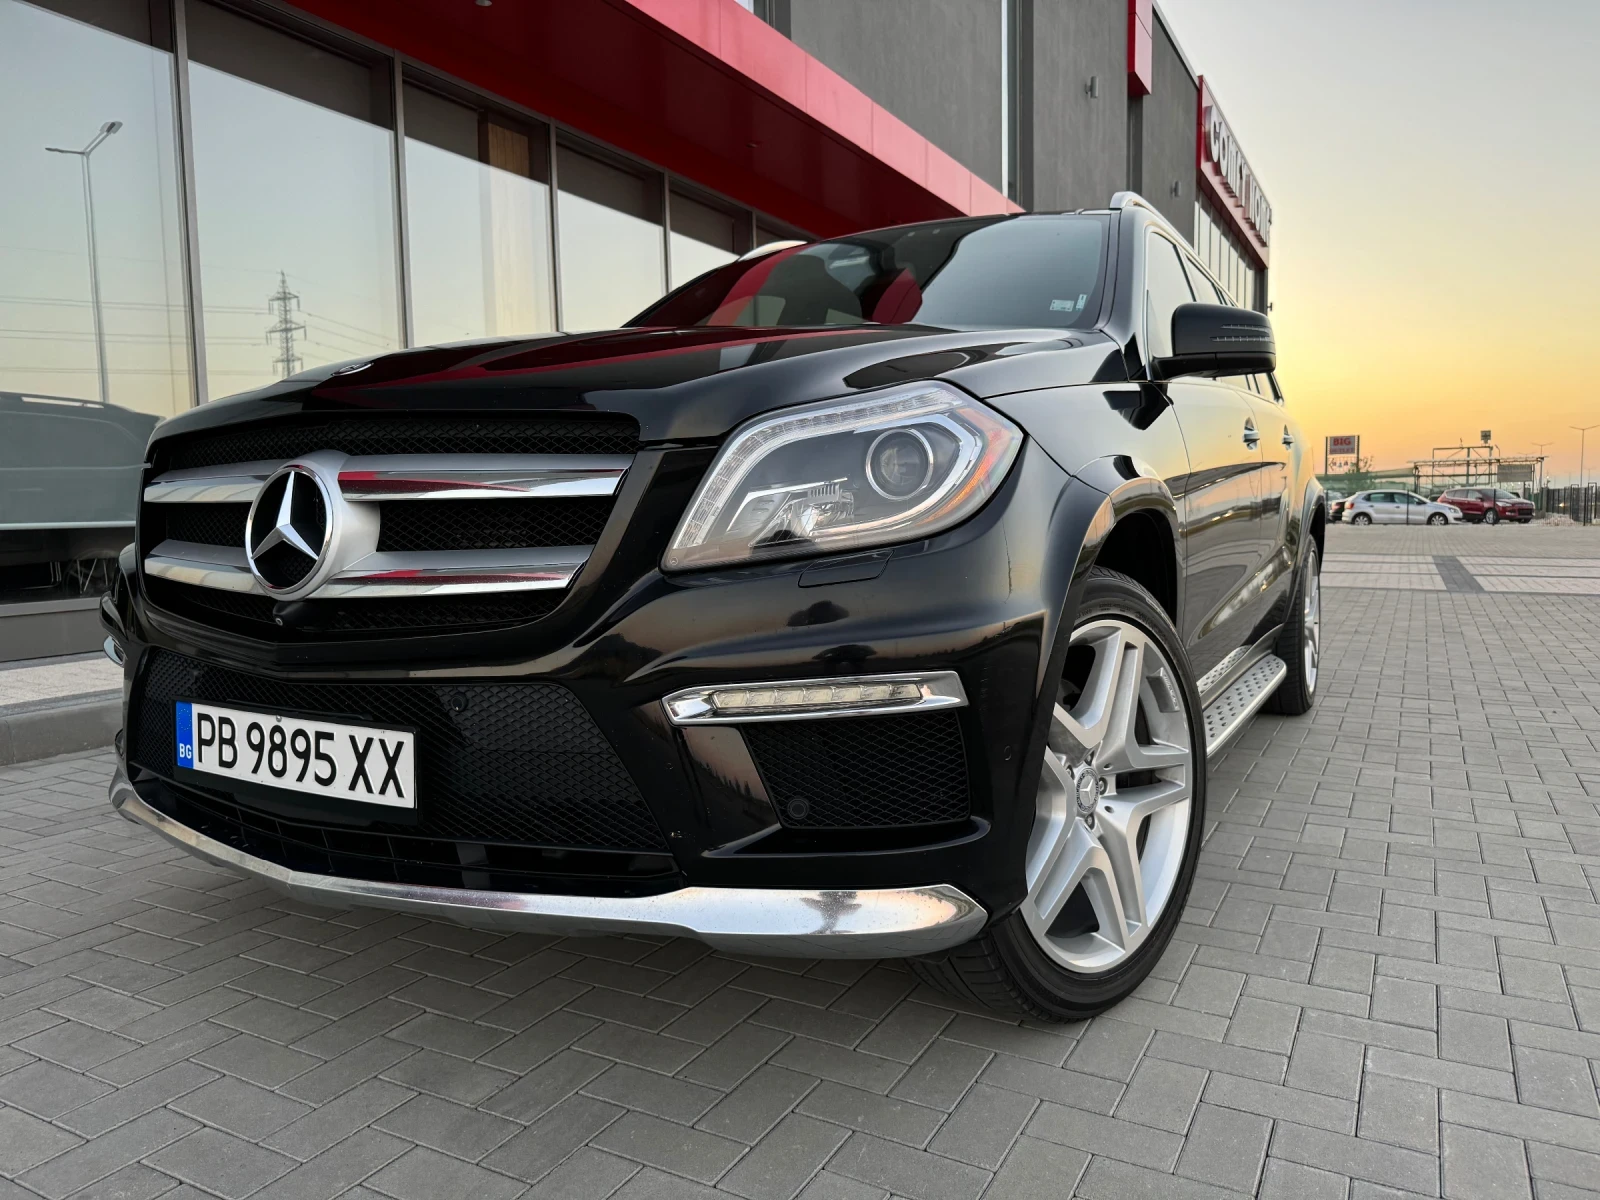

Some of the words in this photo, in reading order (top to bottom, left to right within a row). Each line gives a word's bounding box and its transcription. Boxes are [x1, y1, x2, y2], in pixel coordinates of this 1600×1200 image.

[1333, 437, 1351, 446] BIG
[179, 742, 192, 759] BG
[197, 712, 239, 769] PB
[246, 721, 338, 787] 9895
[348, 734, 406, 799] XX
